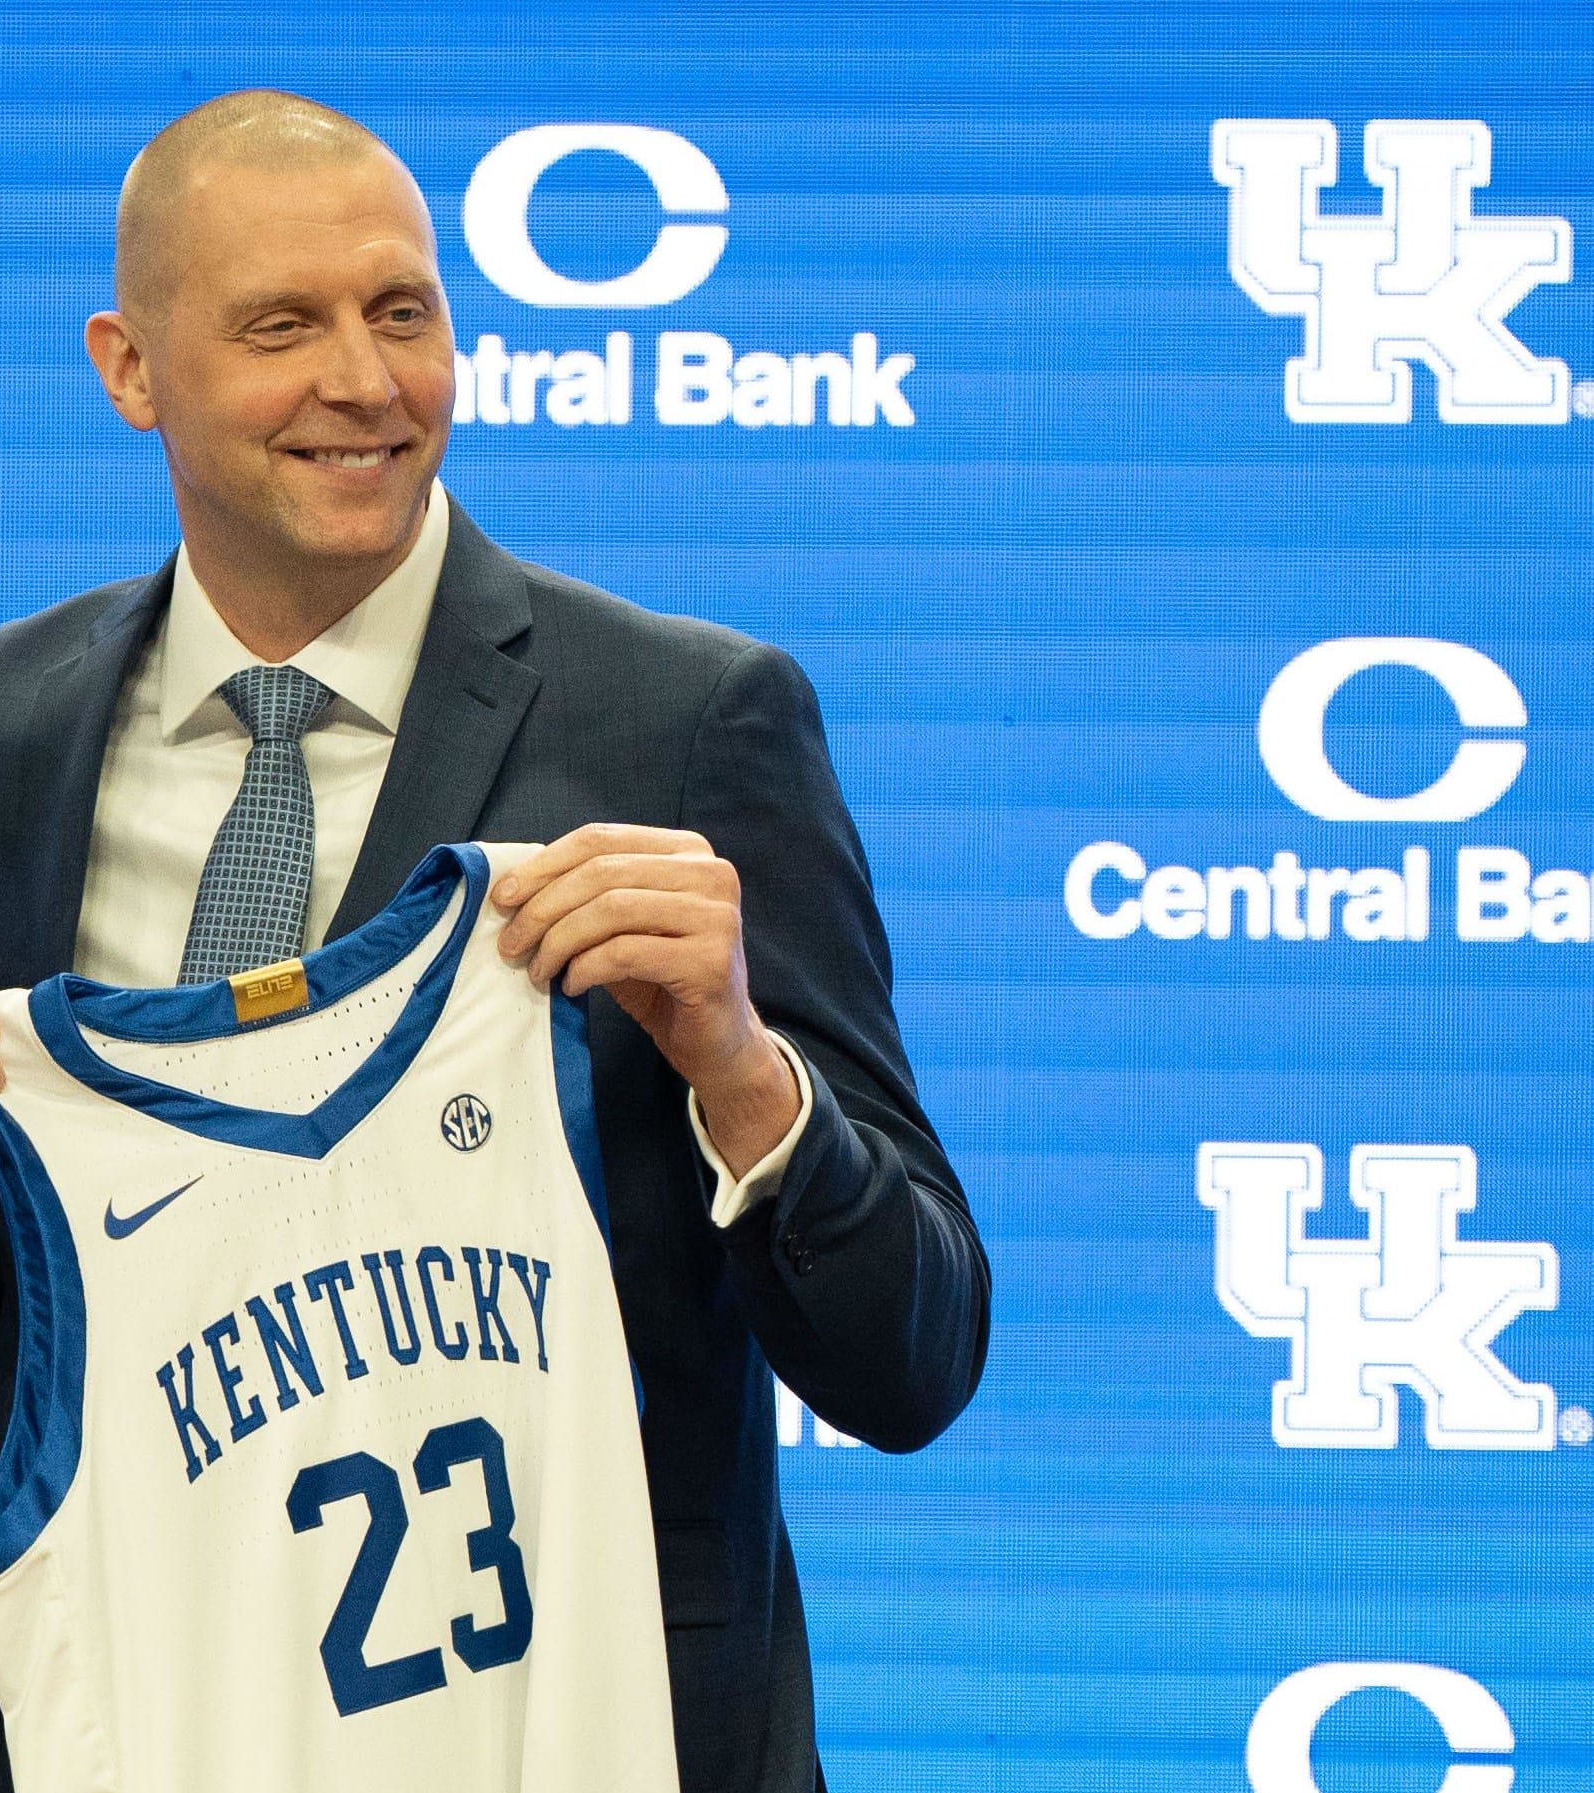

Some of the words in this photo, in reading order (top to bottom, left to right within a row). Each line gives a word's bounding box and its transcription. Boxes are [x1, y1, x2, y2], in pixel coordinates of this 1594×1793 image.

[654, 331, 916, 427] Bank
[1064, 840, 1430, 942] Central
[441, 1093, 492, 1151] SEC
[155, 1246, 551, 1484] KENTUCKY
[285, 1416, 534, 1718] 23
